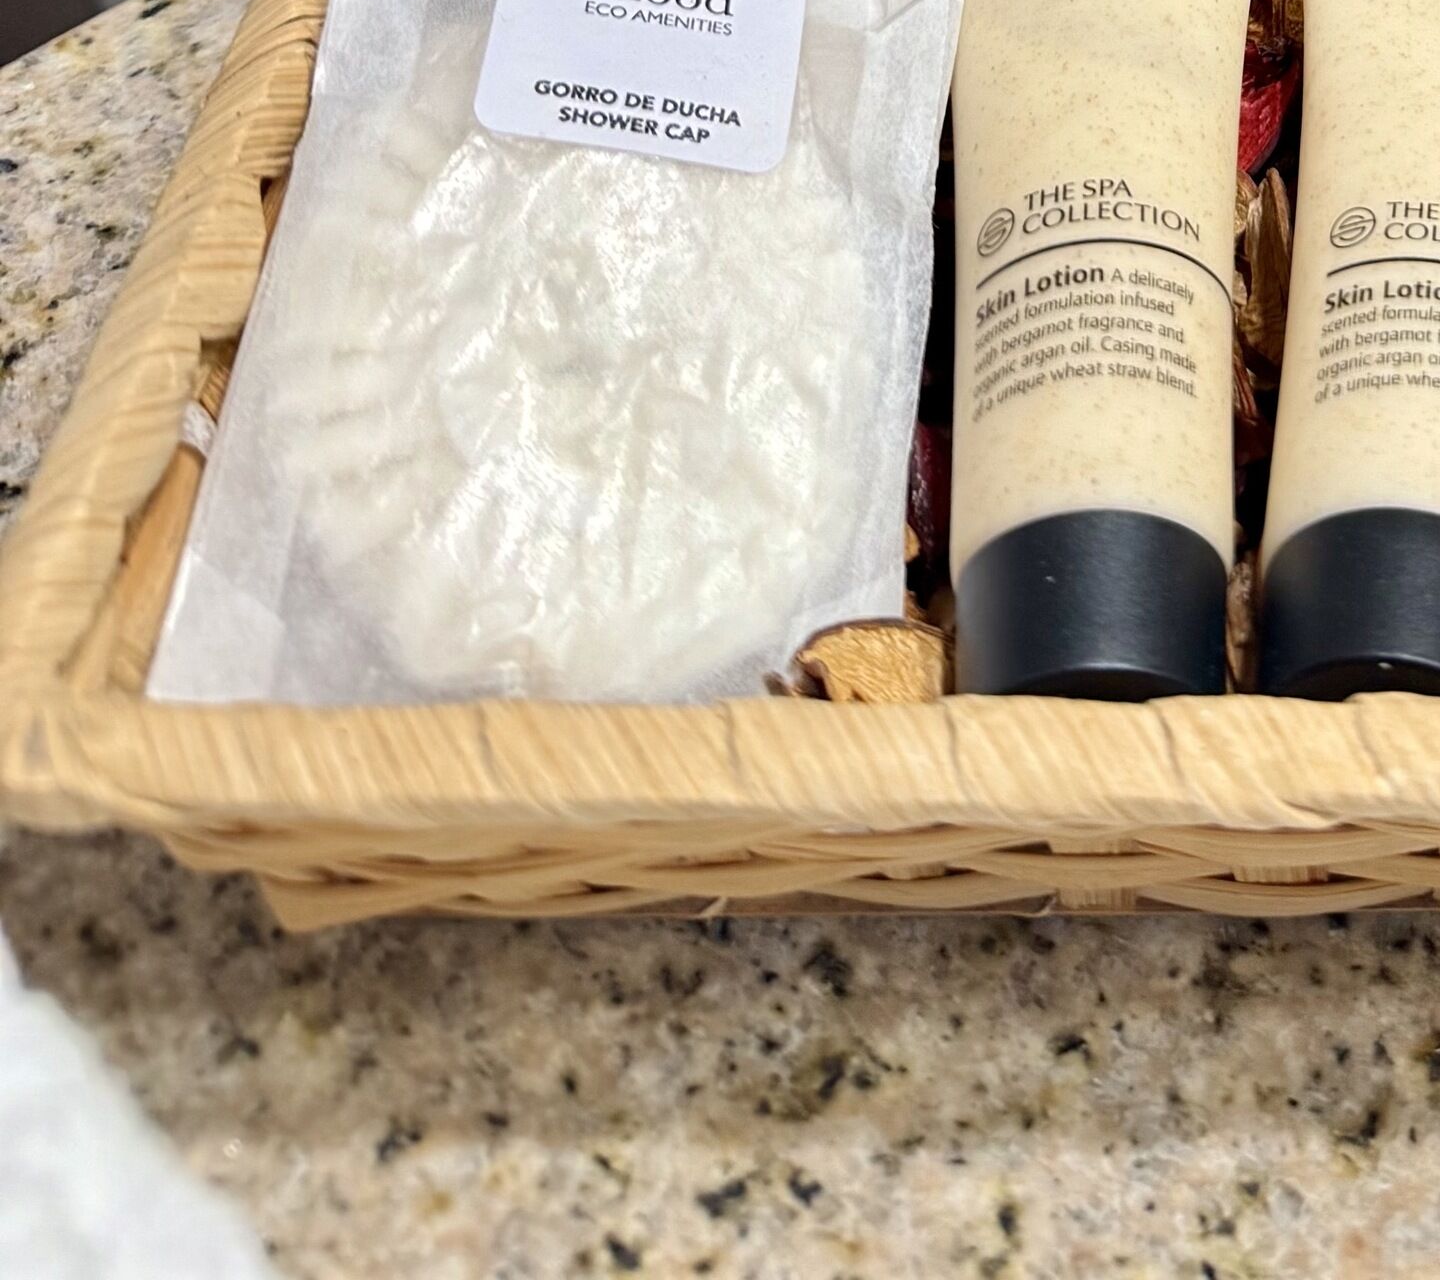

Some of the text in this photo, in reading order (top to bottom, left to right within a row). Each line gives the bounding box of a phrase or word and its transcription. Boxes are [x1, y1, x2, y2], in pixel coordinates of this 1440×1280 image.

[585, 0, 732, 36] ECO AMENITIES
[534, 80, 741, 126] GORRO DE DUCHA
[558, 107, 710, 143] SHOWER CAP
[1024, 179, 1132, 211] THE SPA
[1386, 201, 1440, 220] THE
[1022, 202, 1200, 241] COLLECTION
[976, 266, 1194, 328] Skin Lotion A delicately
[1024, 290, 1114, 320] formulation
[1120, 290, 1174, 316] infused
[1324, 284, 1373, 314] Skin
[1001, 318, 1073, 354] bergamot
[1079, 313, 1153, 333] fragrance
[1158, 324, 1184, 344] and
[1321, 306, 1377, 337] scented
[1021, 343, 1065, 367] argan
[1100, 335, 1154, 360] Casing
[1160, 347, 1197, 374] made
[1319, 335, 1349, 358] with
[1354, 330, 1432, 346] bergamot
[997, 372, 1046, 405] unique
[1050, 361, 1103, 382] wheat
[1108, 362, 1152, 379] straw
[1316, 352, 1372, 381] organic
[1375, 351, 1422, 367] argan
[1314, 382, 1329, 403] of
[1332, 383, 1342, 396] a
[1346, 372, 1402, 392] unique
